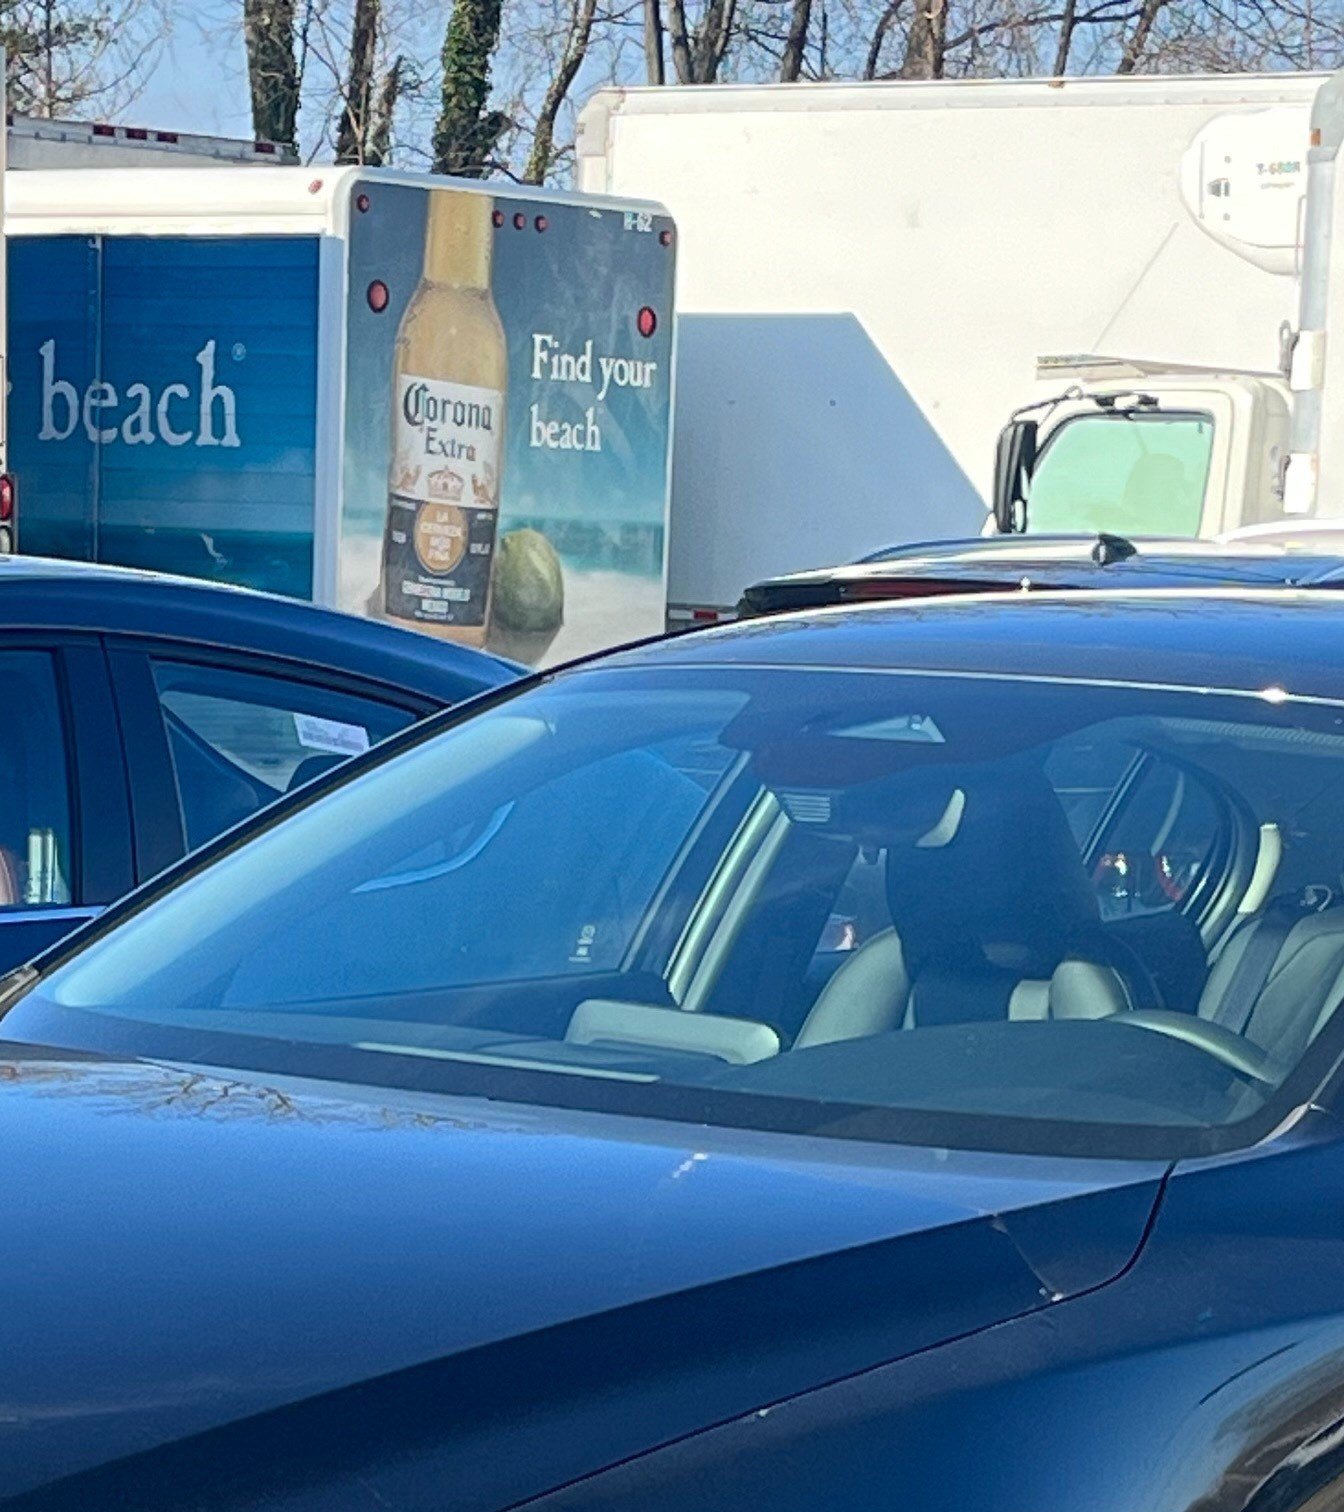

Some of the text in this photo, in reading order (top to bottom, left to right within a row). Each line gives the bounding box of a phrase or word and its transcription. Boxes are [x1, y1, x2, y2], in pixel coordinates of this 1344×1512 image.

[531, 333, 658, 401] Find your
[38, 338, 241, 448] beach
[403, 382, 493, 432] Corona
[424, 426, 477, 462] Extra
[529, 403, 601, 451] beach
